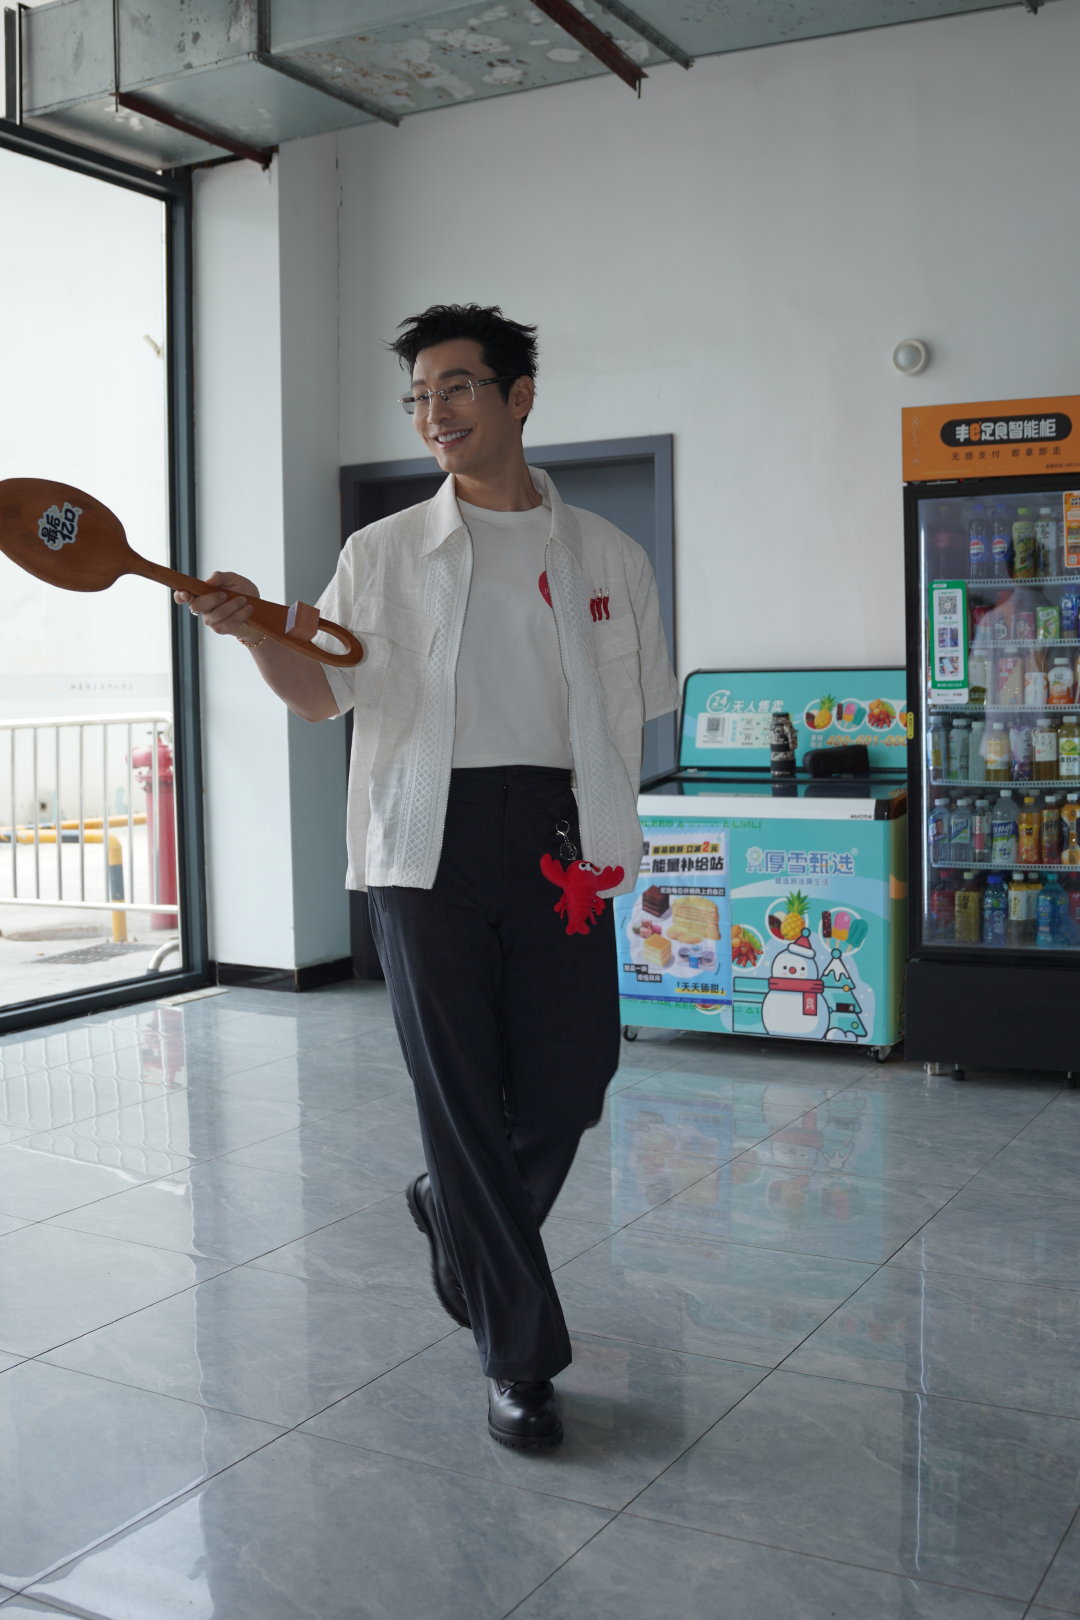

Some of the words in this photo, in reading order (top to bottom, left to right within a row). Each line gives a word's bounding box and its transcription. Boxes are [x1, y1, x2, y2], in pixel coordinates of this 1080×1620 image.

[955, 418, 1056, 442] 丰e足食智能柜
[952, 450, 1000, 461] 无感支付
[711, 695, 727, 710] 24
[730, 699, 784, 712] 无人售卖
[652, 856, 724, 873] 能量补给站
[764, 851, 854, 875] 厚雪甄选
